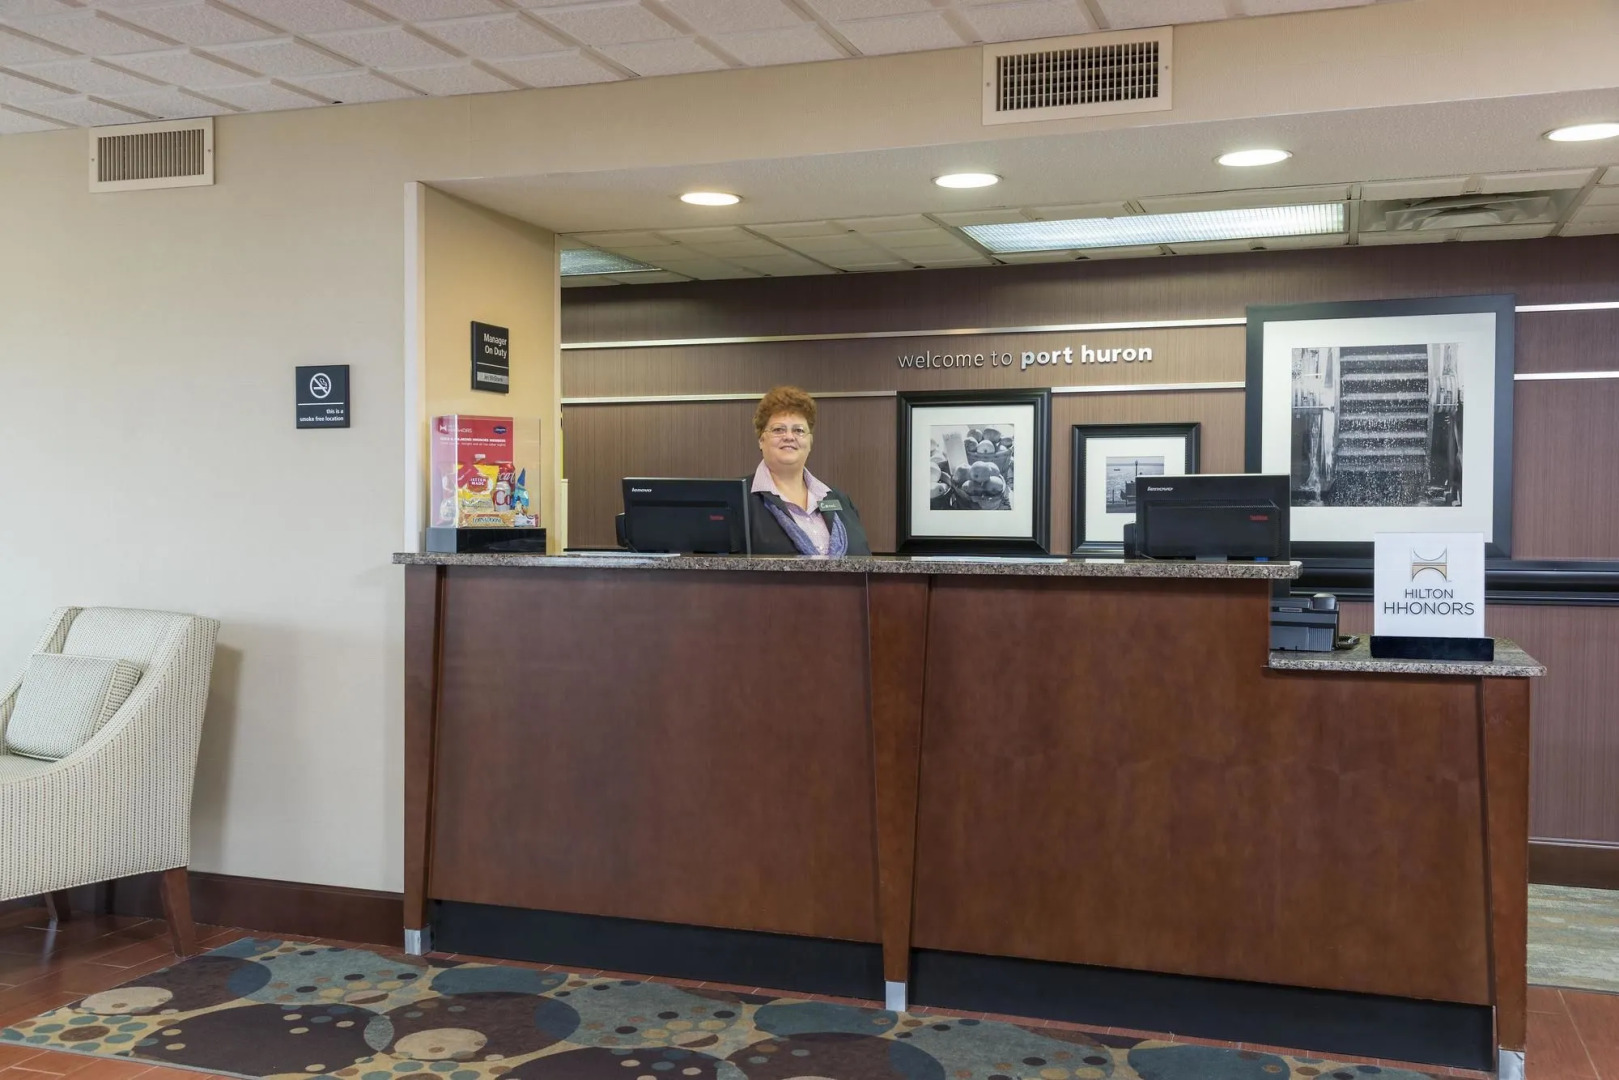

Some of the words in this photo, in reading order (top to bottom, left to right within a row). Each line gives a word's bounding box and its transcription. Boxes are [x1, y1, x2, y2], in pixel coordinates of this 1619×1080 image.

[483, 332, 507, 347] Manager
[484, 344, 493, 355] On
[494, 346, 507, 359] Duty
[897, 350, 984, 369] welcome
[990, 350, 1013, 367] to
[1020, 345, 1073, 370] port
[1080, 344, 1153, 364] huron
[1404, 588, 1454, 599] HILTON
[1383, 601, 1475, 616] HHONORS
